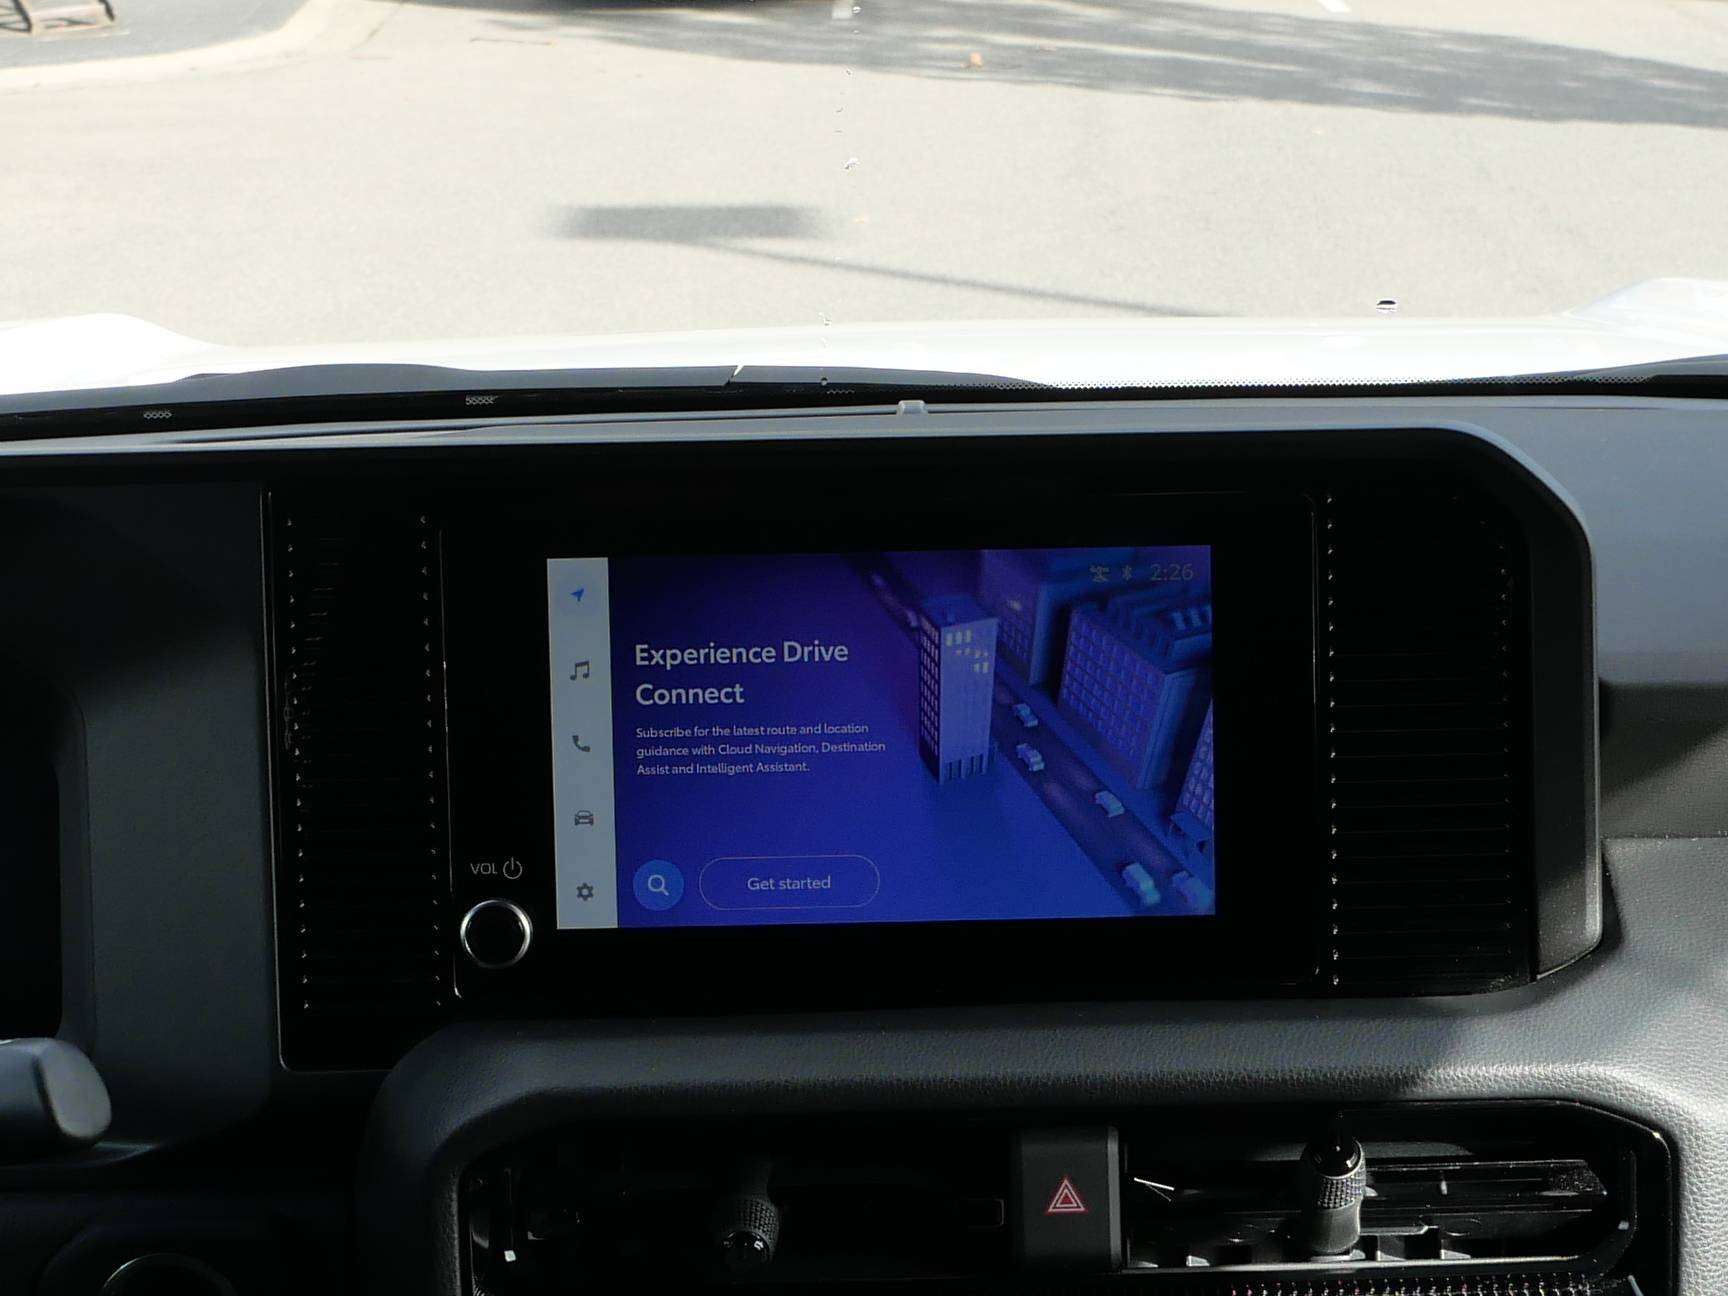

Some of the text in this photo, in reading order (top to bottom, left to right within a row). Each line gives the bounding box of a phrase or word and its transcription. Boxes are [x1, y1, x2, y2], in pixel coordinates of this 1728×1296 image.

[1149, 562, 1195, 583] 2:26
[635, 640, 849, 671] Experience Drive
[635, 683, 745, 706] Connect
[636, 722, 869, 738] Subscribe for the latest route and location
[636, 741, 886, 758] guidance with Cloud Navigation, Destination
[636, 761, 811, 776] Assist and Intelligent Assistant.
[469, 862, 498, 876] VOL
[747, 875, 831, 891] Get started
